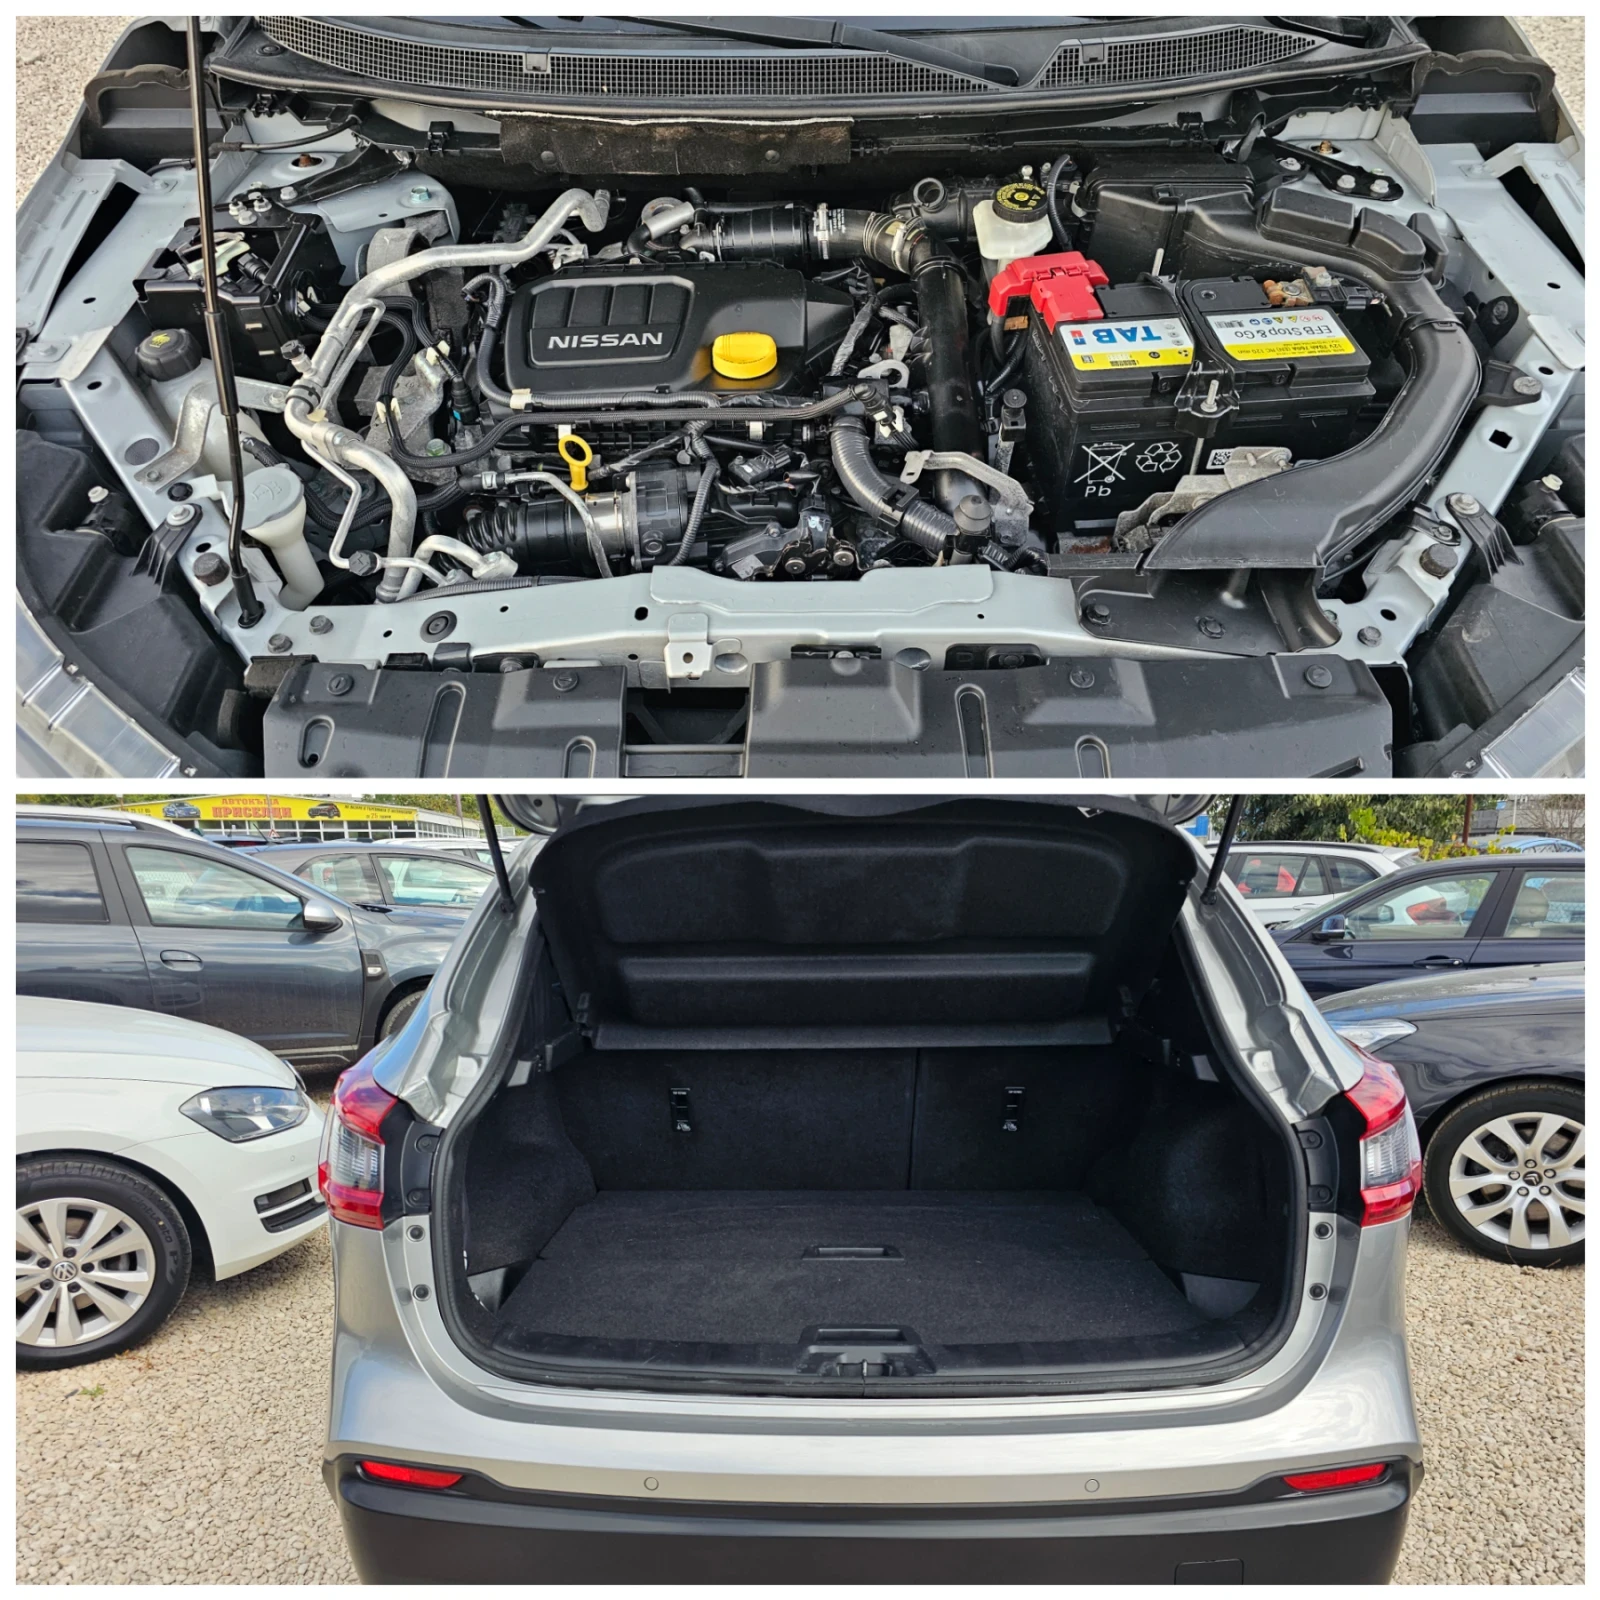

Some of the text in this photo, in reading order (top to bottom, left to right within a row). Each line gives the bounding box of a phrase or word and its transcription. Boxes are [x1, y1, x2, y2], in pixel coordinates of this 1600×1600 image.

[1092, 325, 1162, 343] TAB
[1235, 330, 1255, 339] Go
[1268, 327, 1302, 336] Stop
[1303, 324, 1332, 334] EFB
[547, 332, 663, 349] NISSAN
[1084, 486, 1112, 498] Pb
